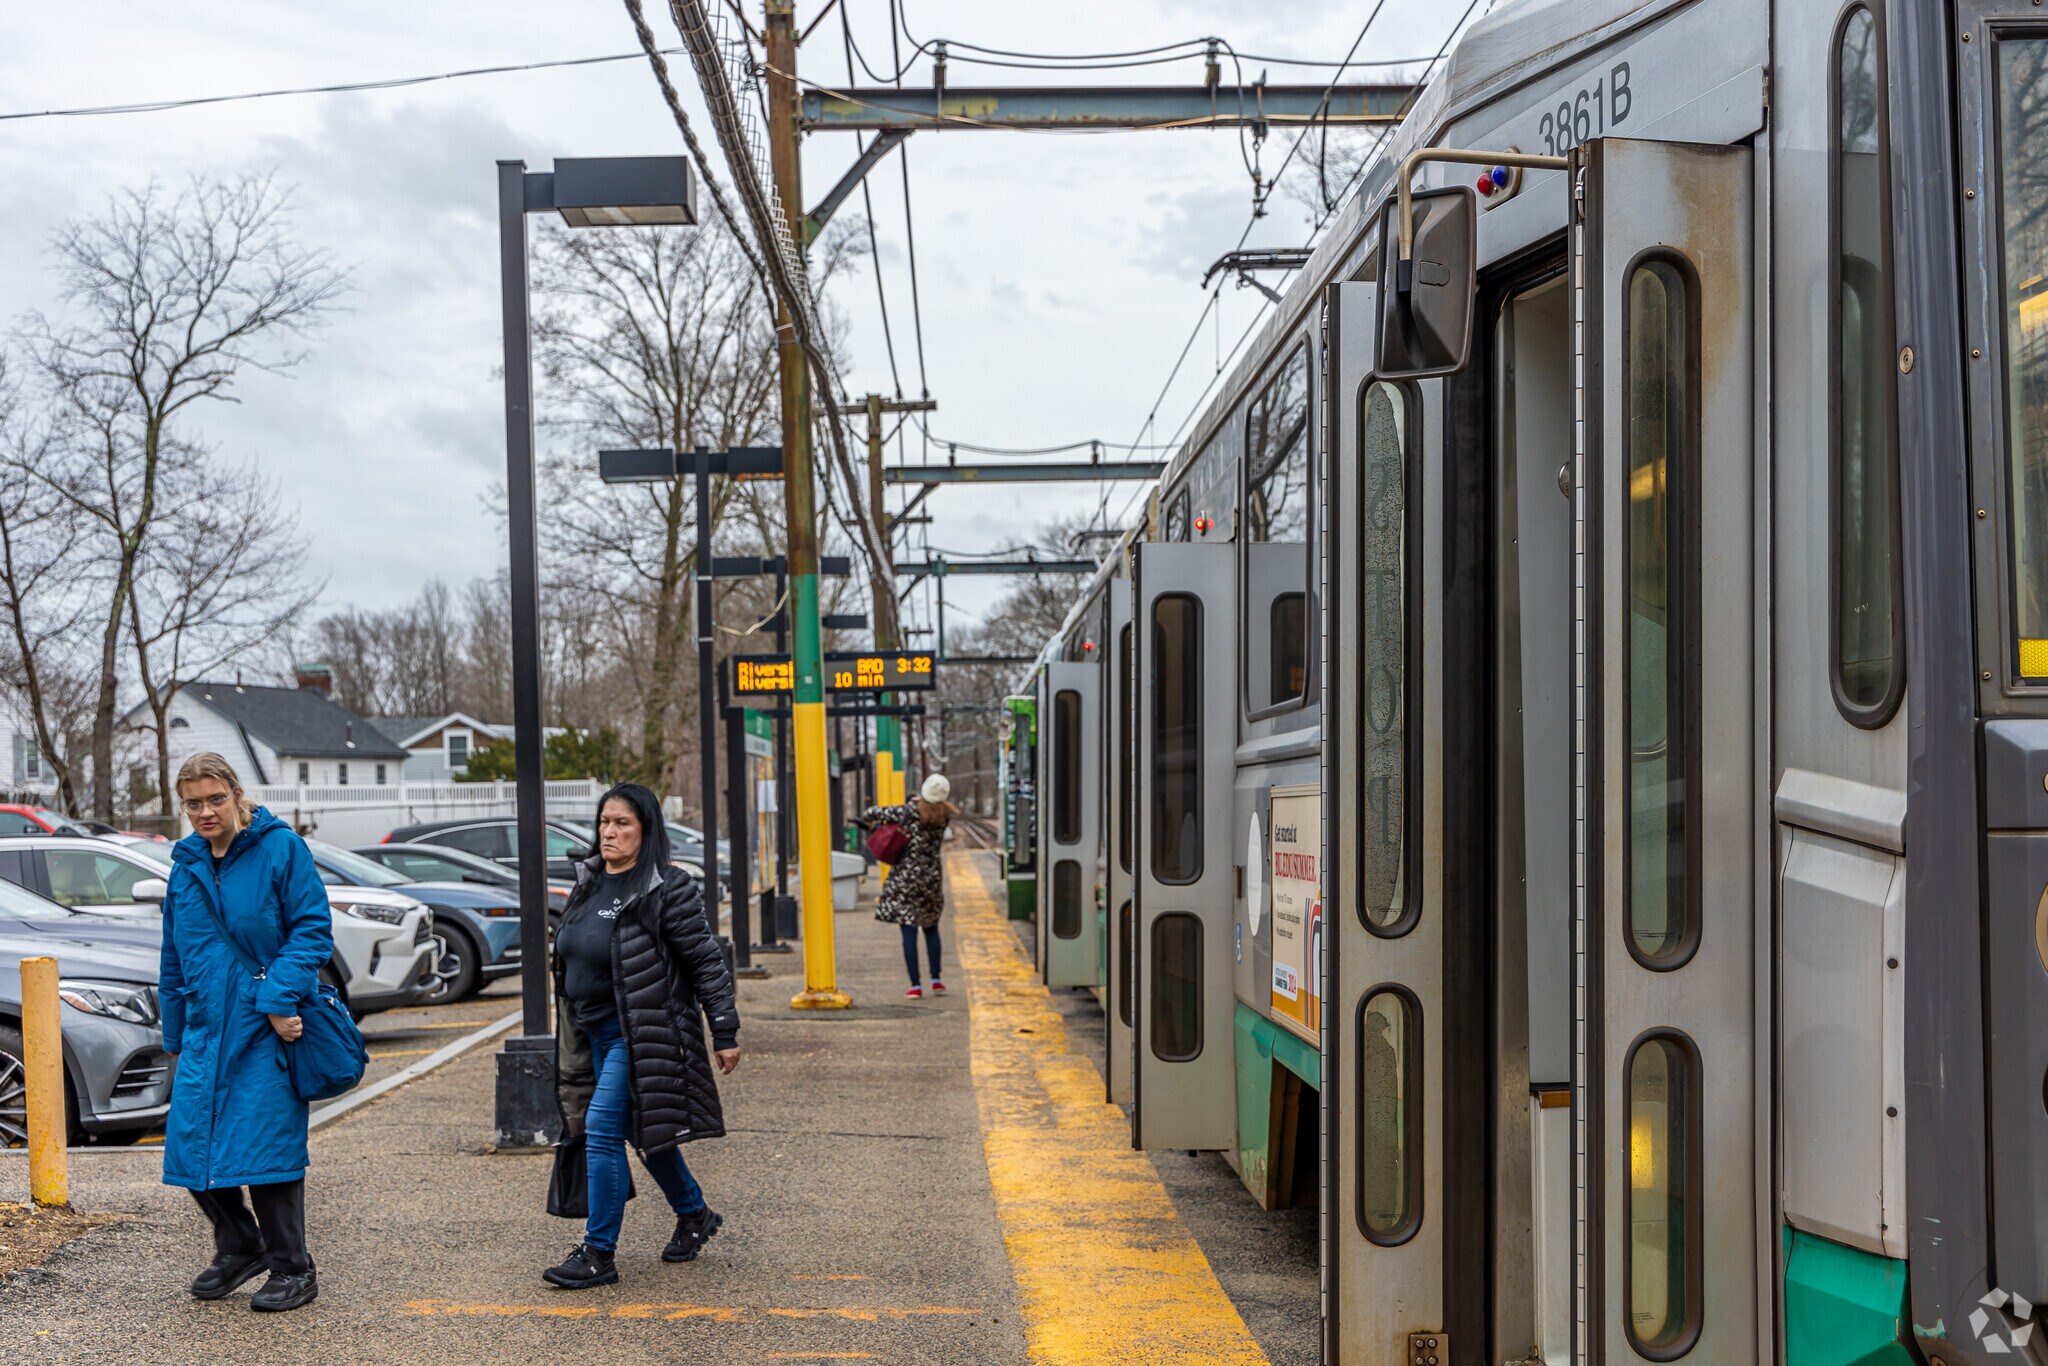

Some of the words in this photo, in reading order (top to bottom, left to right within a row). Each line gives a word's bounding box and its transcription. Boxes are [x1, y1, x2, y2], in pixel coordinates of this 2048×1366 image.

[1539, 62, 1631, 157] 3861B
[897, 657, 931, 673] 3:32
[834, 672, 853, 688] 10
[857, 673, 885, 687] min
